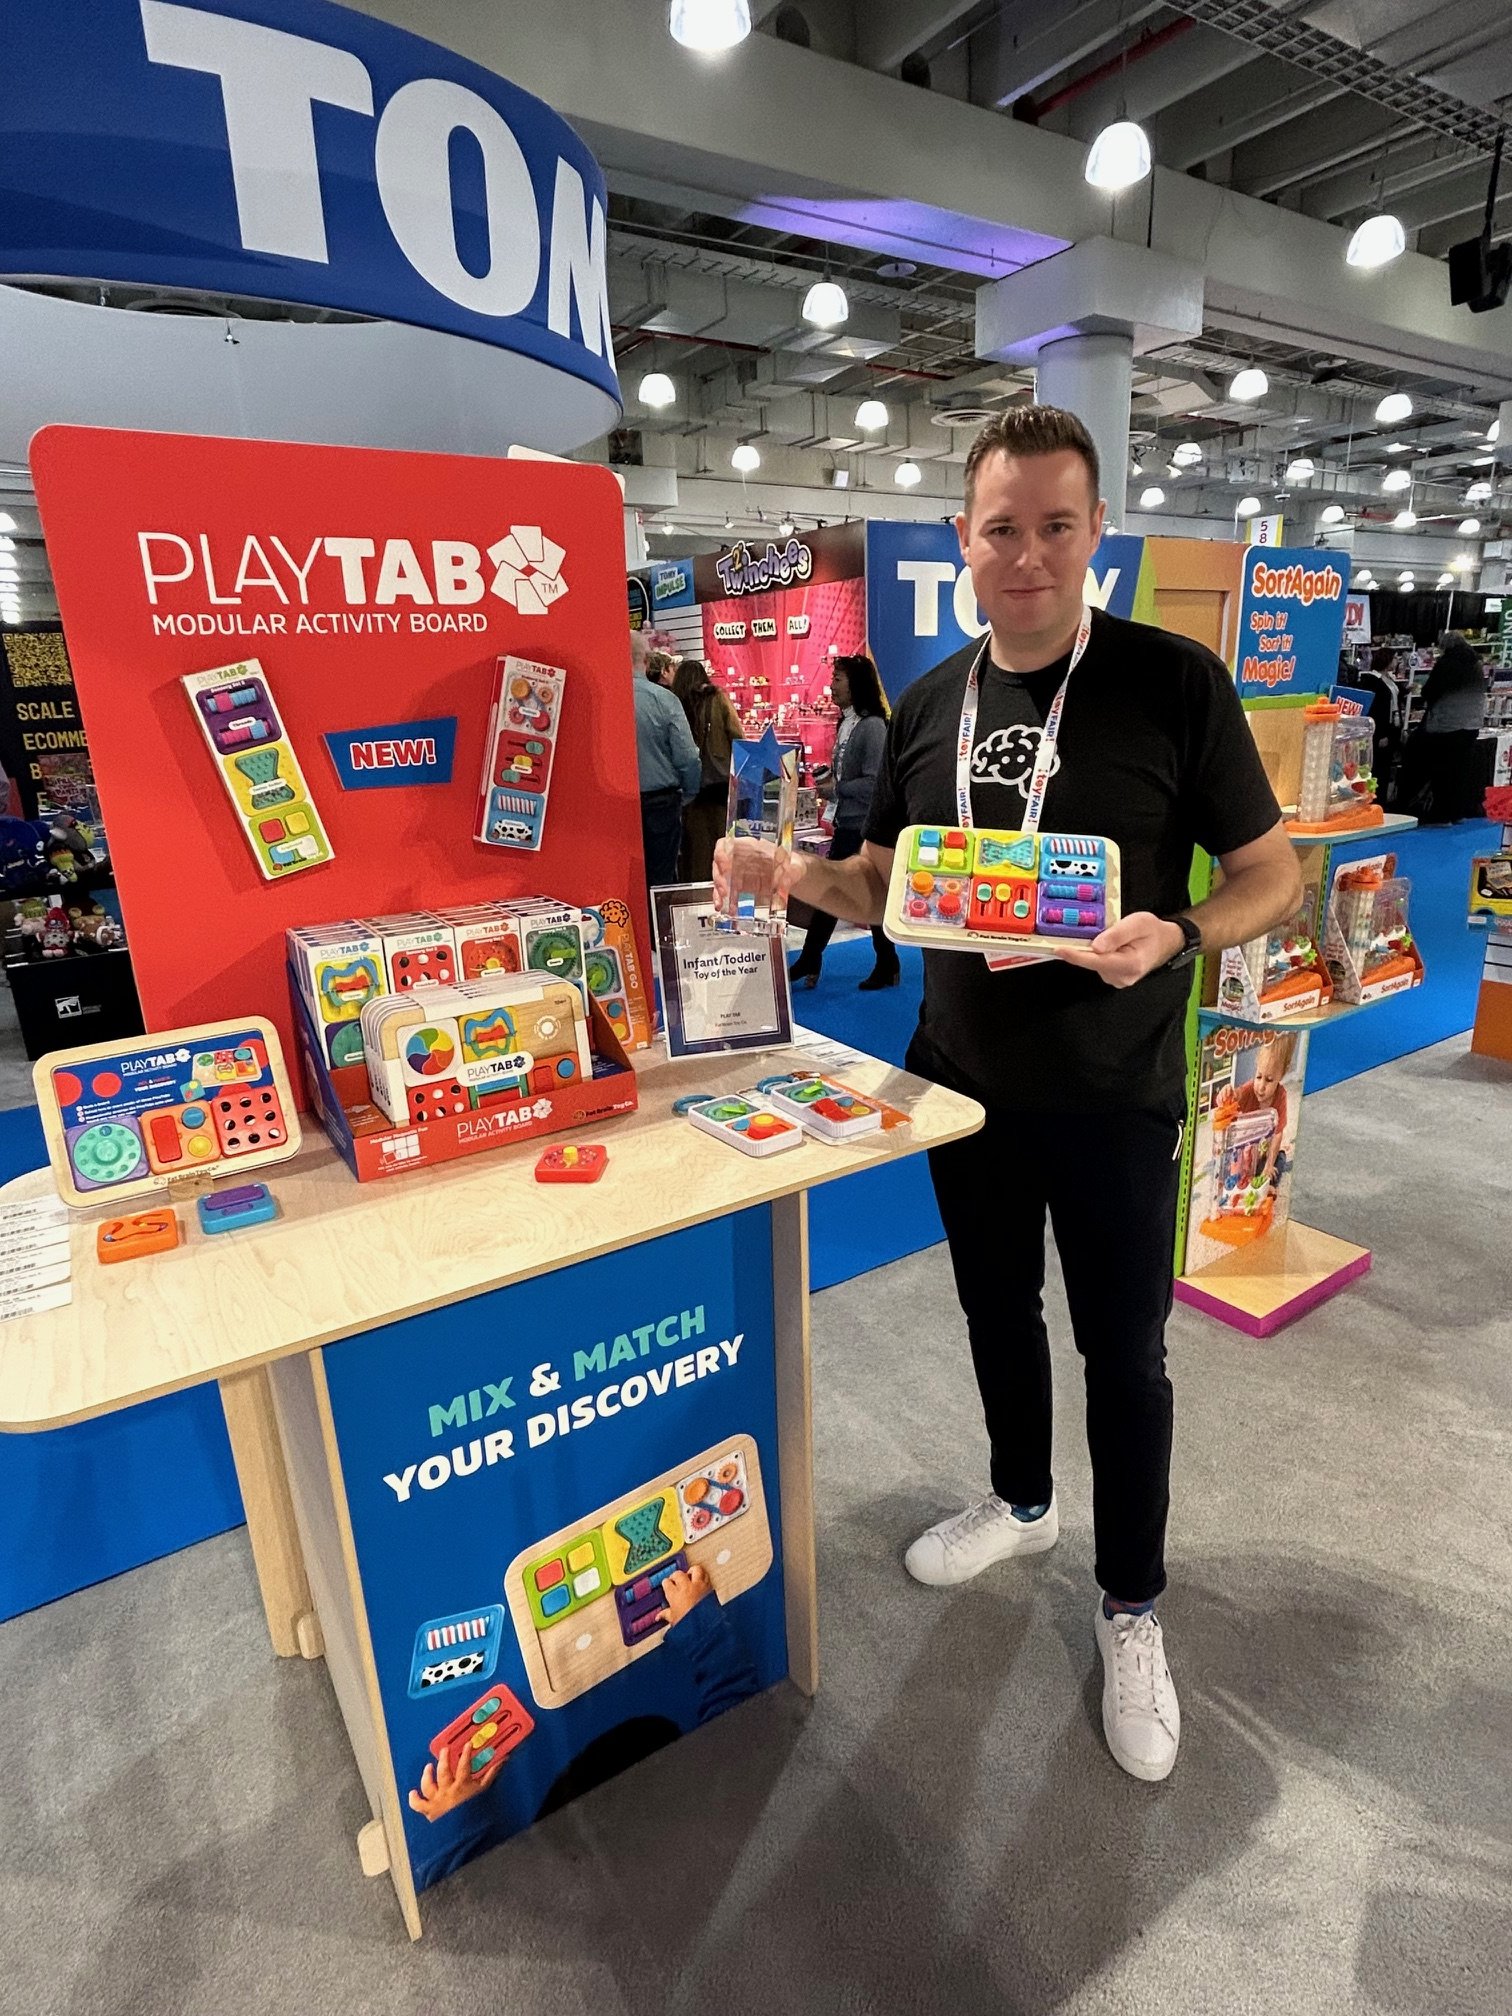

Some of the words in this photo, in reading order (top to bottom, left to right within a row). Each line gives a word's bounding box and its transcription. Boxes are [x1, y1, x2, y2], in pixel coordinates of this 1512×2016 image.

[136, 531, 488, 606] PLAYTAB
[1252, 562, 1342, 606] SortAgain
[897, 560, 1120, 638] TOY
[153, 612, 287, 637] MODULAR
[295, 612, 402, 635] ACTIVITY
[409, 612, 488, 633] BOARD
[715, 624, 746, 637] COLLECT
[753, 620, 775, 635] THEM
[788, 616, 808, 631] ALL!
[1251, 612, 1273, 633] Spin
[1259, 634, 1281, 652] Sort
[1243, 656, 1296, 687] Magic!
[16, 701, 75, 721] SCALE
[349, 736, 437, 770] NEW!
[683, 952, 766, 970] Infant/Toddler
[629, 977, 638, 989] GO
[694, 971, 709, 980] Toy
[711, 969, 721, 978] of
[722, 967, 736, 976] the
[738, 966, 758, 974] Year
[121, 1052, 176, 1073] PLAYTAB
[467, 1060, 513, 1078] PLAYTAB
[456, 1105, 532, 1138] PLAYTAB
[428, 1376, 516, 1438] MIX
[528, 1363, 561, 1398] &
[573, 1305, 706, 1382] MATCH
[382, 1428, 515, 1503] YOUR
[526, 1334, 745, 1449] DISCOVERY
